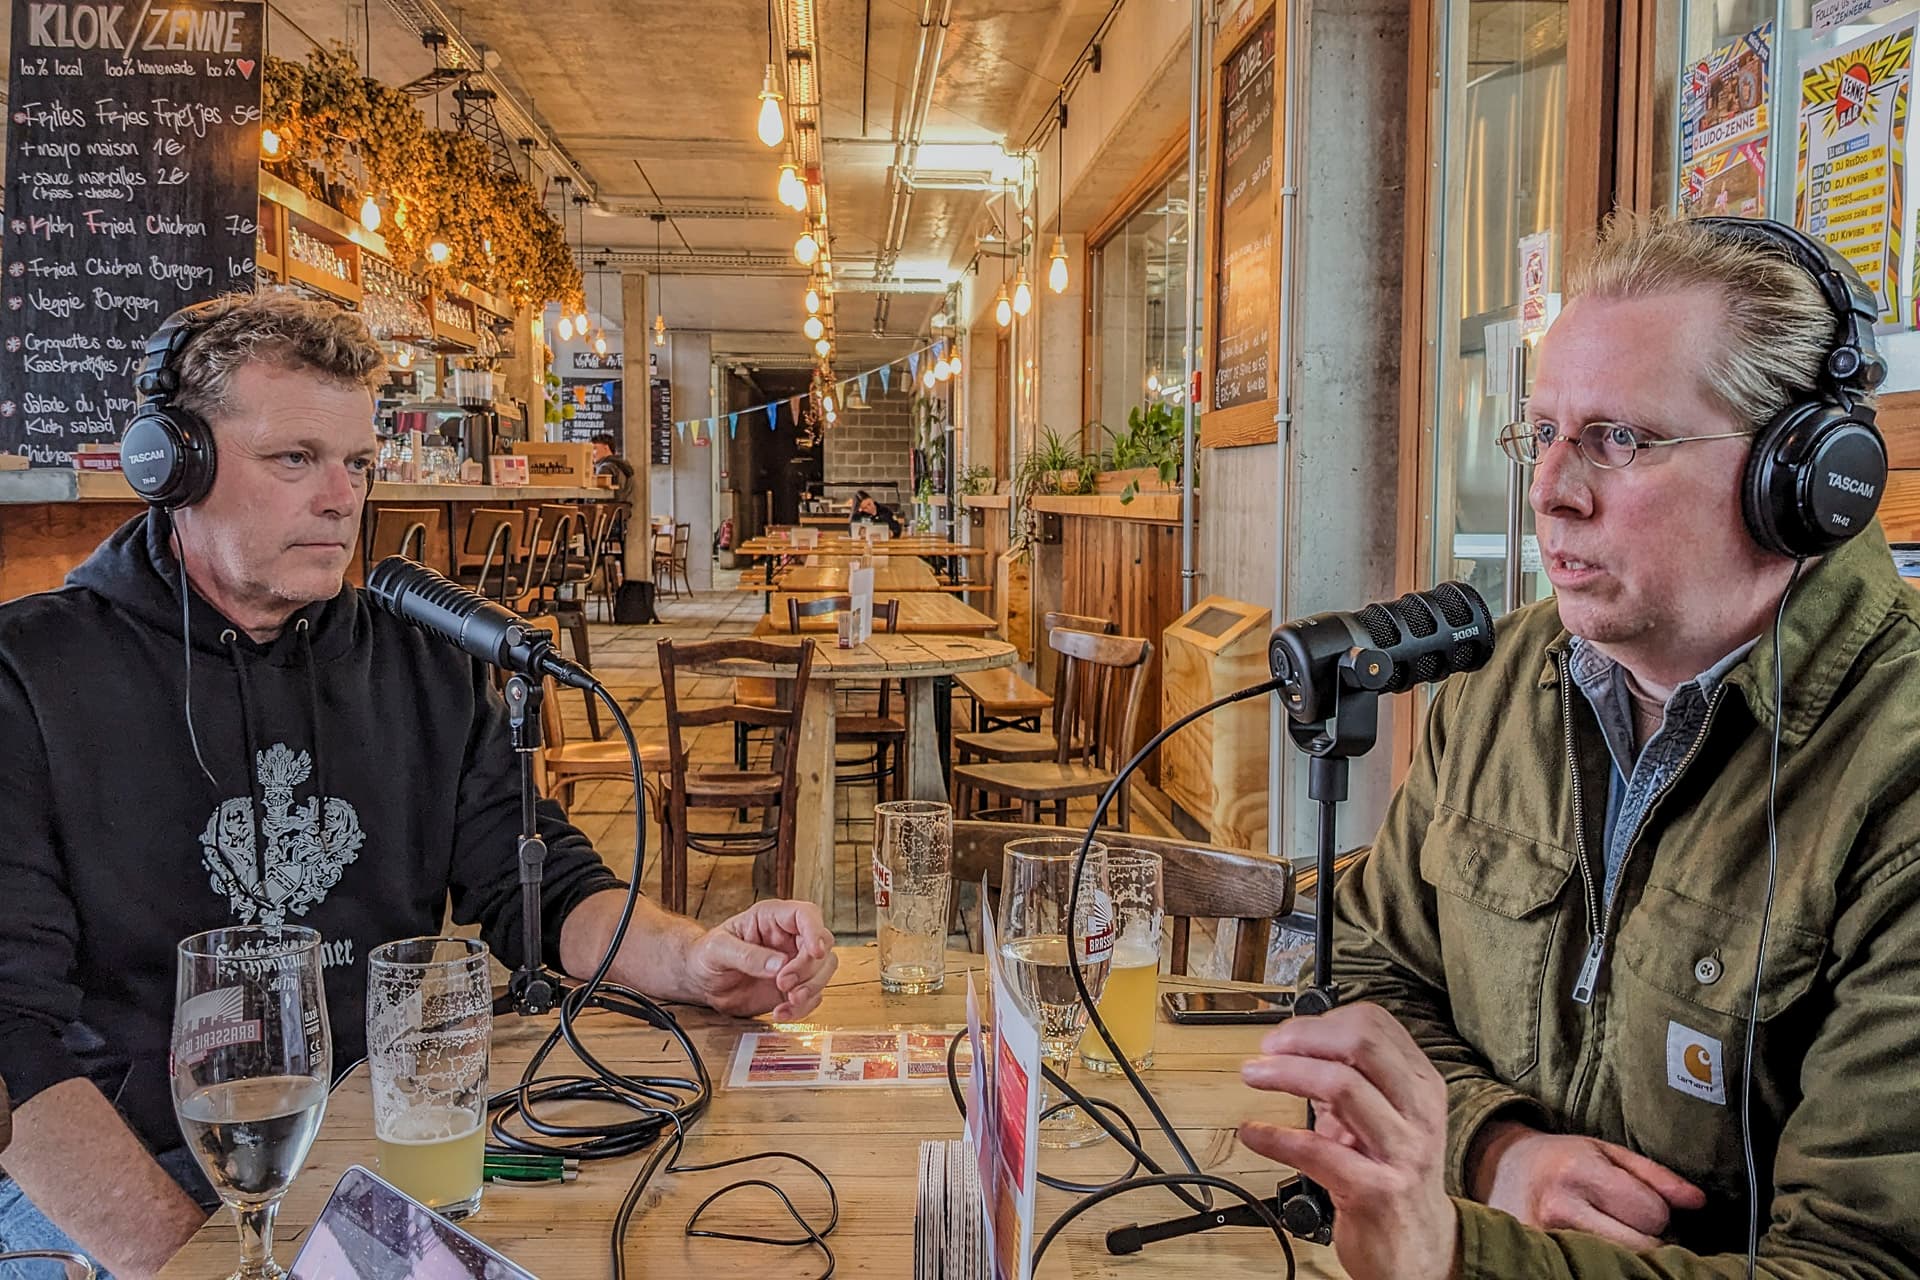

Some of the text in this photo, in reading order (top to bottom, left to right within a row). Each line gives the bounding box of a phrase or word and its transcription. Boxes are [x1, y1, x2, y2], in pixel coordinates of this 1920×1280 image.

[20, 58, 236, 77] 100% local 100% homemade 100%
[1843, 77, 1866, 102] ZENNE
[22, 99, 86, 132] Frites
[95, 98, 149, 132] Fries
[230, 105, 261, 126] 5€
[1839, 103, 1860, 127] BAR
[87, 139, 139, 157] maison
[153, 138, 186, 156] 1€
[157, 167, 190, 185] 2€
[82, 209, 137, 239] Fried
[146, 213, 206, 237] Chicken
[225, 215, 257, 236] 7€
[28, 255, 257, 291] Fried Chicken Burger 10€
[28, 286, 159, 322] Veggie Burger
[25, 332, 101, 355] Croquettes
[106, 336, 127, 350] de
[24, 389, 136, 421] Salade du jour
[128, 449, 165, 465] TASCAM
[1827, 471, 1876, 499] TASCAM
